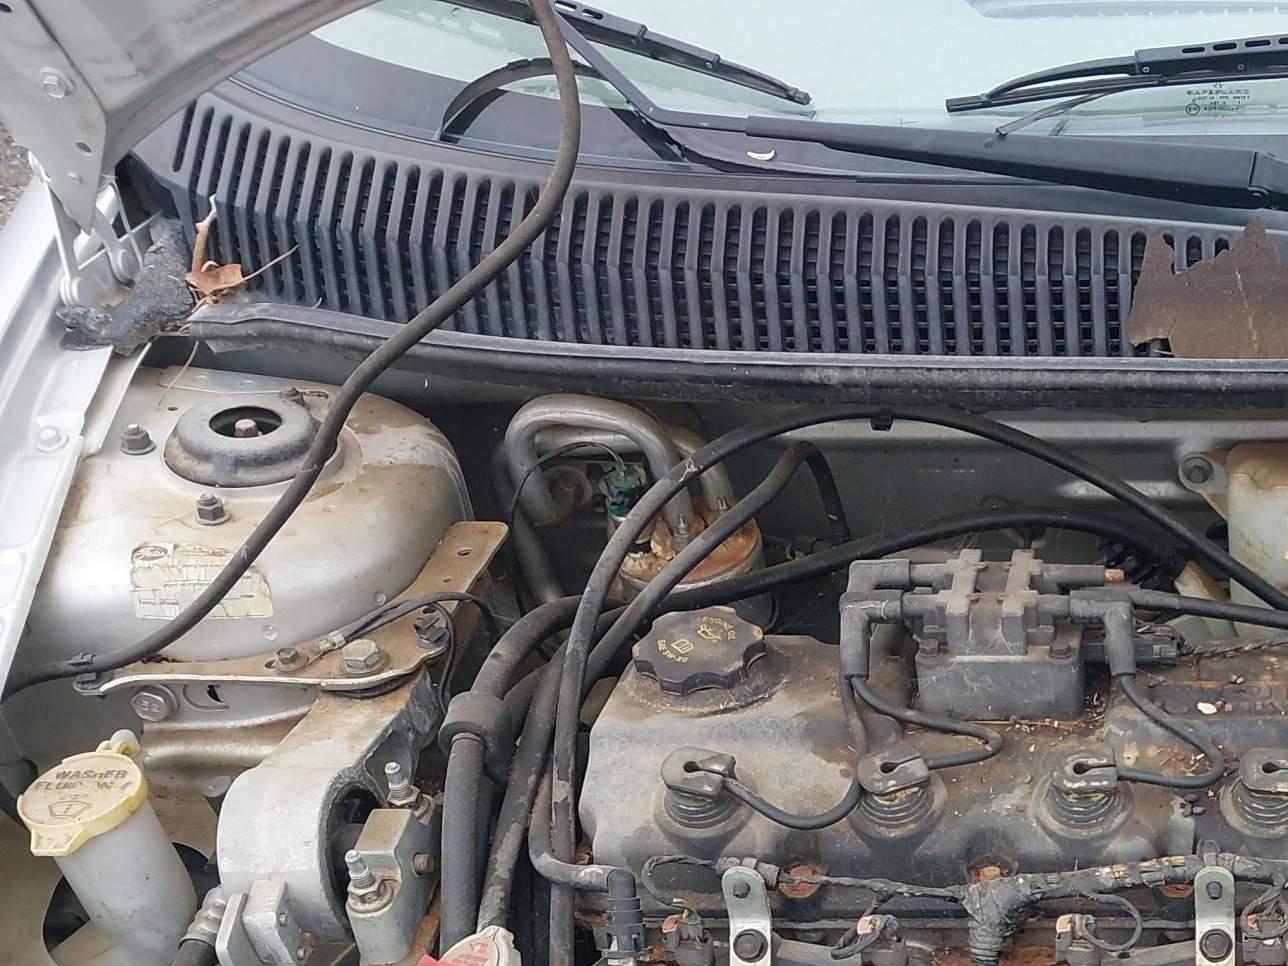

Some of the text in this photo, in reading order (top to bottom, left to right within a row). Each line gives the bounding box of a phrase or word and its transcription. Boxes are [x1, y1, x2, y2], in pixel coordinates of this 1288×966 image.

[702, 616, 734, 631] ENGINE
[657, 639, 688, 663] SAE 5W-20
